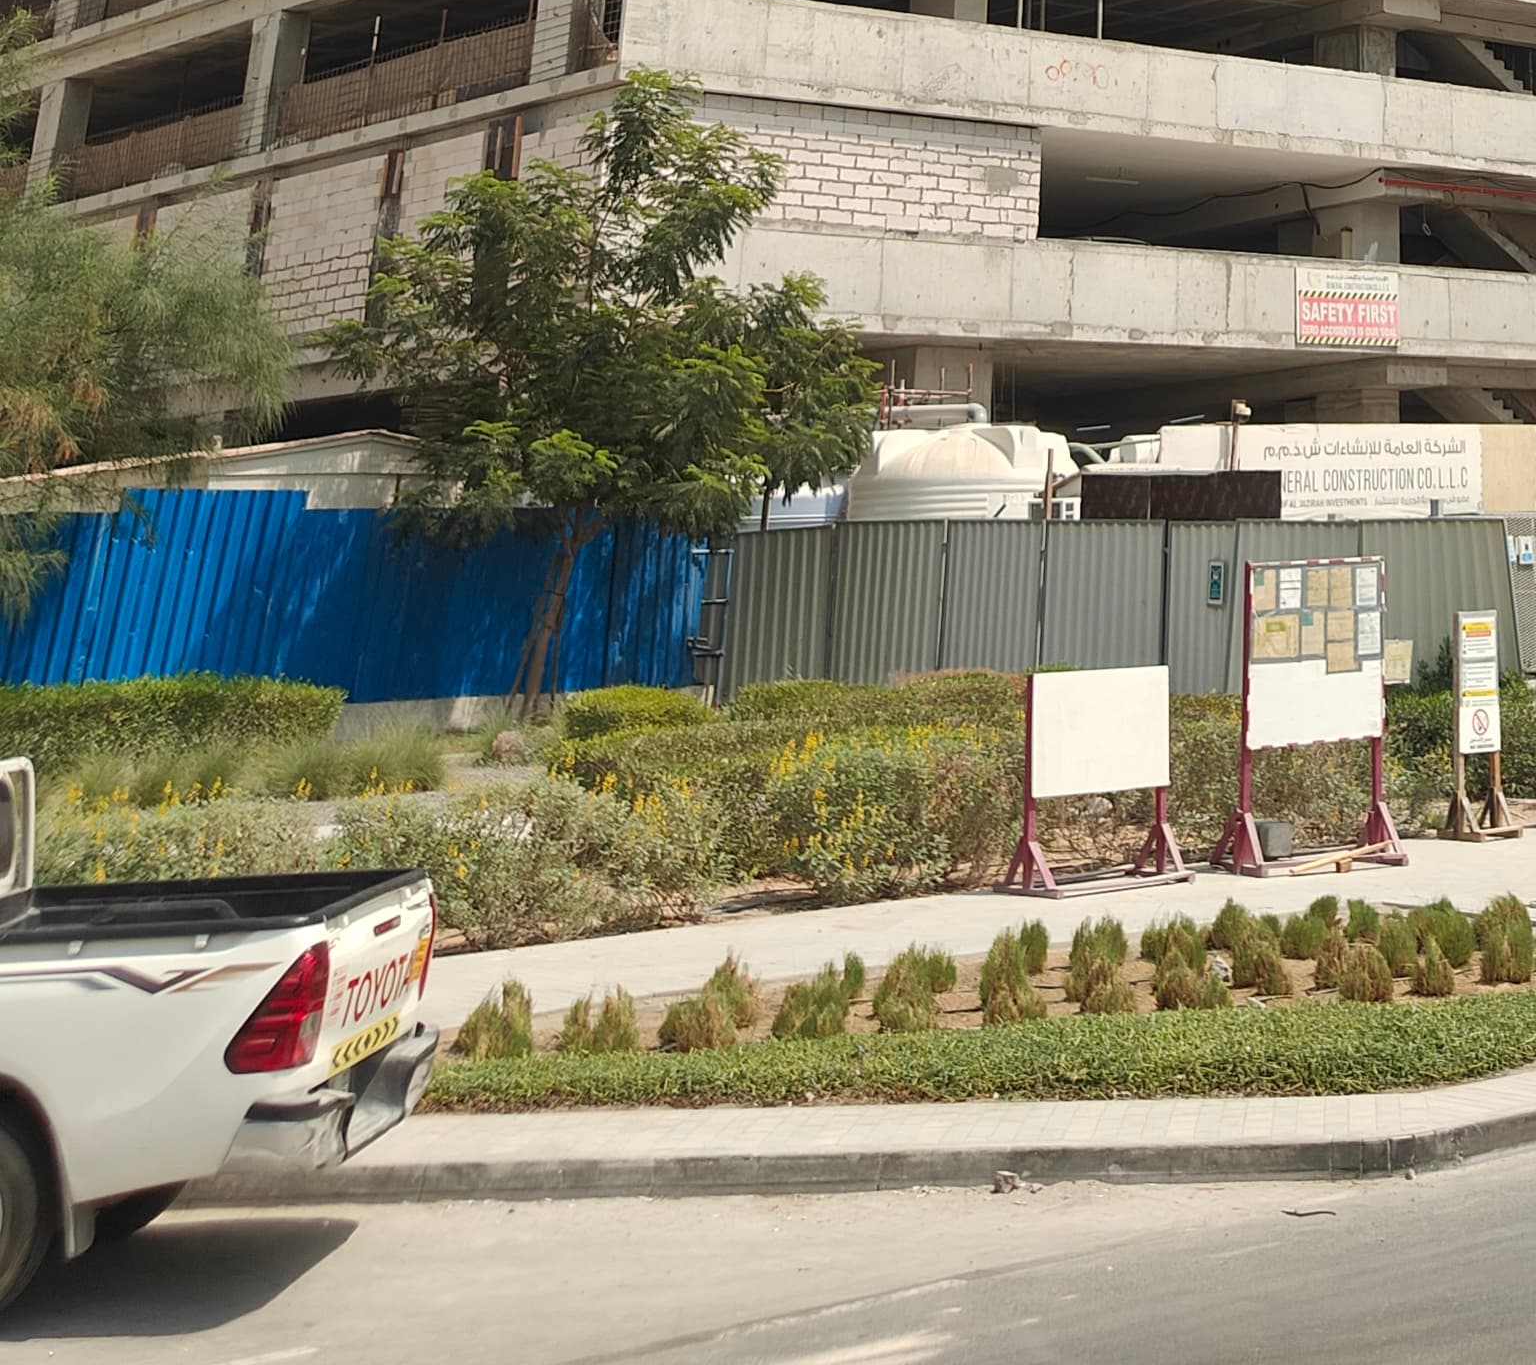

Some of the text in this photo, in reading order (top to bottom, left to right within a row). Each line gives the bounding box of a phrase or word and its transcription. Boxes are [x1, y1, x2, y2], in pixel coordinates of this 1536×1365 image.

[1302, 302, 1396, 325] SAFETY FIRST
[1324, 437, 1381, 459] للإنشاءات
[1384, 438, 1422, 456] العامة
[1424, 437, 1466, 457] الشركة
[1324, 468, 1414, 492] CONSTRUCTION
